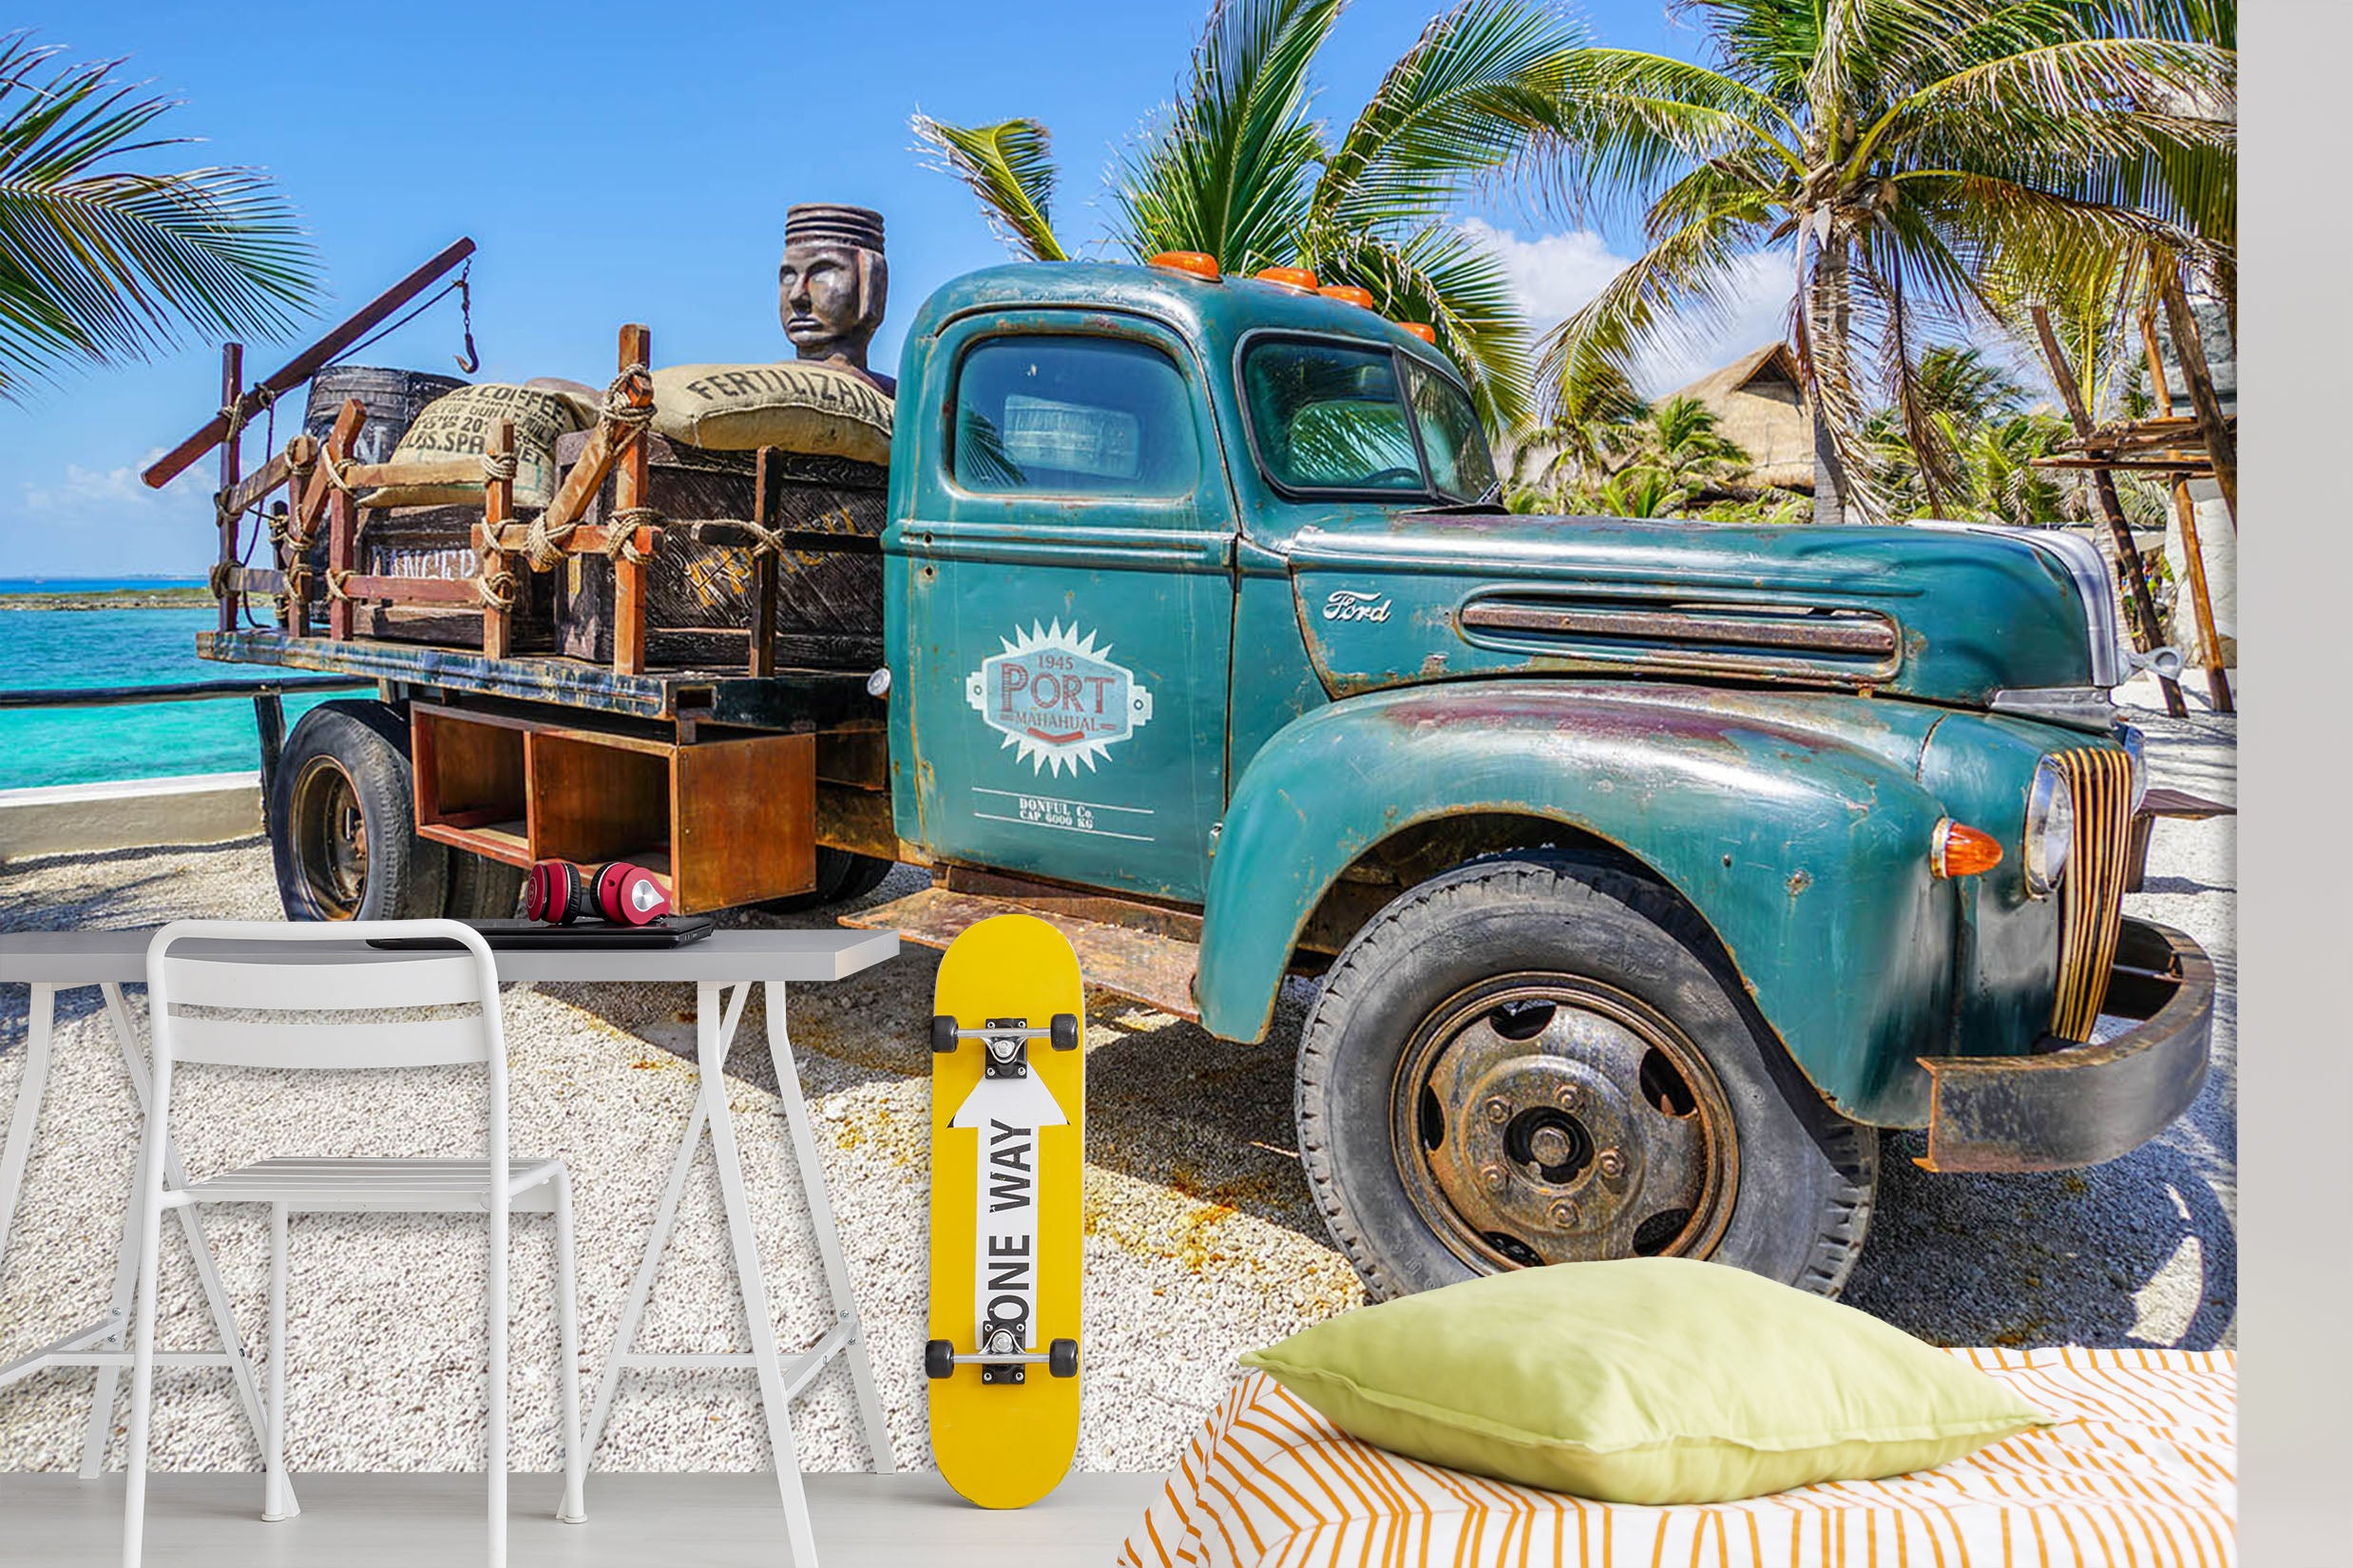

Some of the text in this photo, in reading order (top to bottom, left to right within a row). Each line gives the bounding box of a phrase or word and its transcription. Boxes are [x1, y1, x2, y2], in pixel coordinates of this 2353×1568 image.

[1323, 589, 1392, 622] Ford
[1038, 655, 1074, 670] 1945
[1001, 662, 1116, 715] PORT
[1016, 711, 1100, 732] MAHAHUAL
[1019, 797, 1071, 815] DONFUL
[1020, 810, 1093, 830] CAP 6000 KG
[986, 1118, 1031, 1323] ONE WAY
